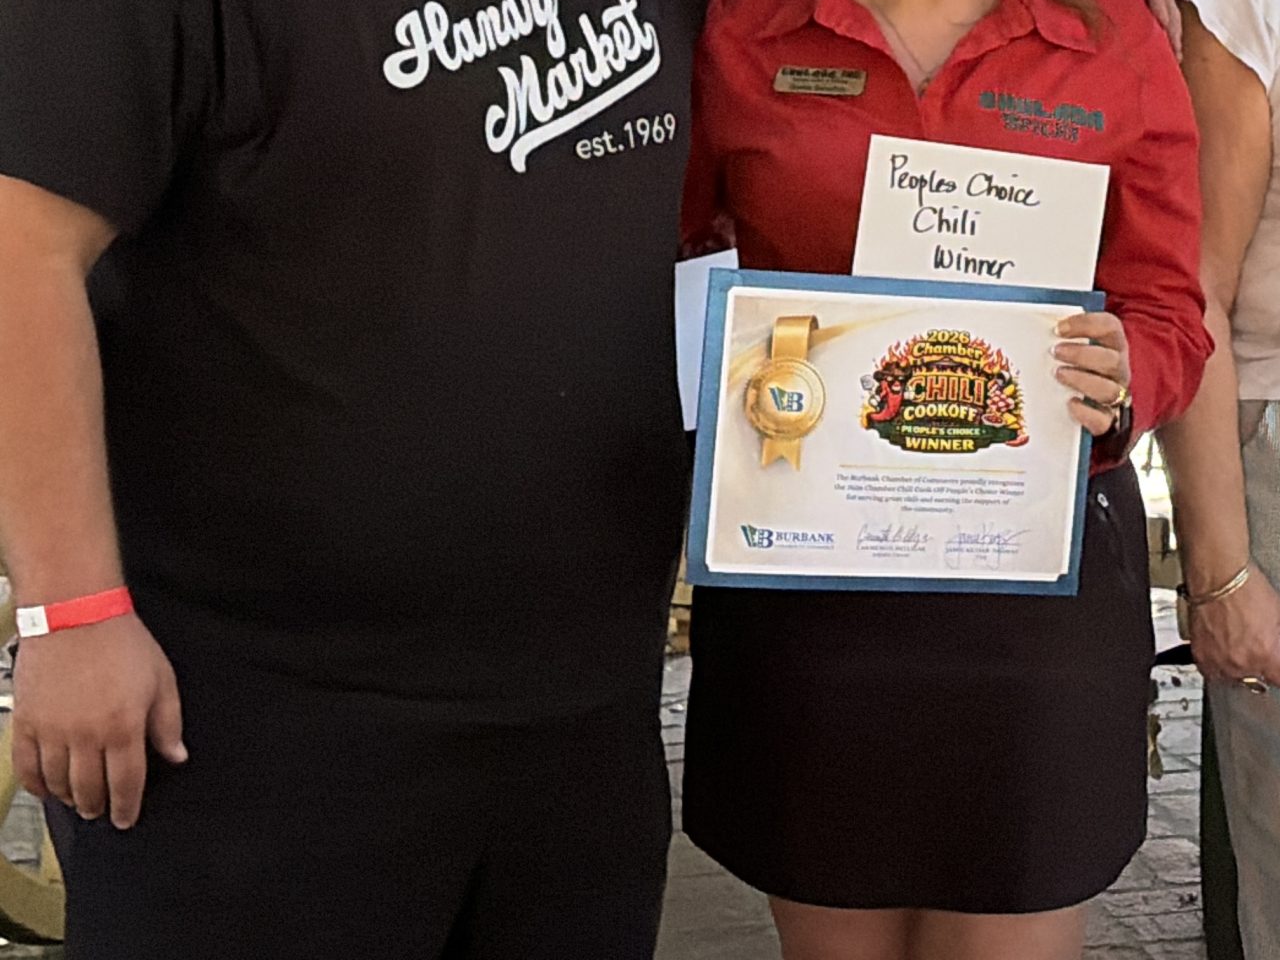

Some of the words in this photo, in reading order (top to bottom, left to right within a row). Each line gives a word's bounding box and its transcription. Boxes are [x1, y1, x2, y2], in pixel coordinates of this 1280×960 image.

[890, 154, 957, 207] Peoples
[966, 172, 1041, 207] Choice
[912, 205, 981, 236] Chili
[933, 245, 1015, 279] Winner
[927, 329, 970, 344] 2026
[913, 342, 983, 359] Chamber
[910, 375, 987, 406] CHILI
[903, 403, 978, 421] COOKOFF
[946, 427, 982, 436] CHOICE
[905, 436, 975, 451] WINNER
[775, 531, 835, 544] BURBANK
